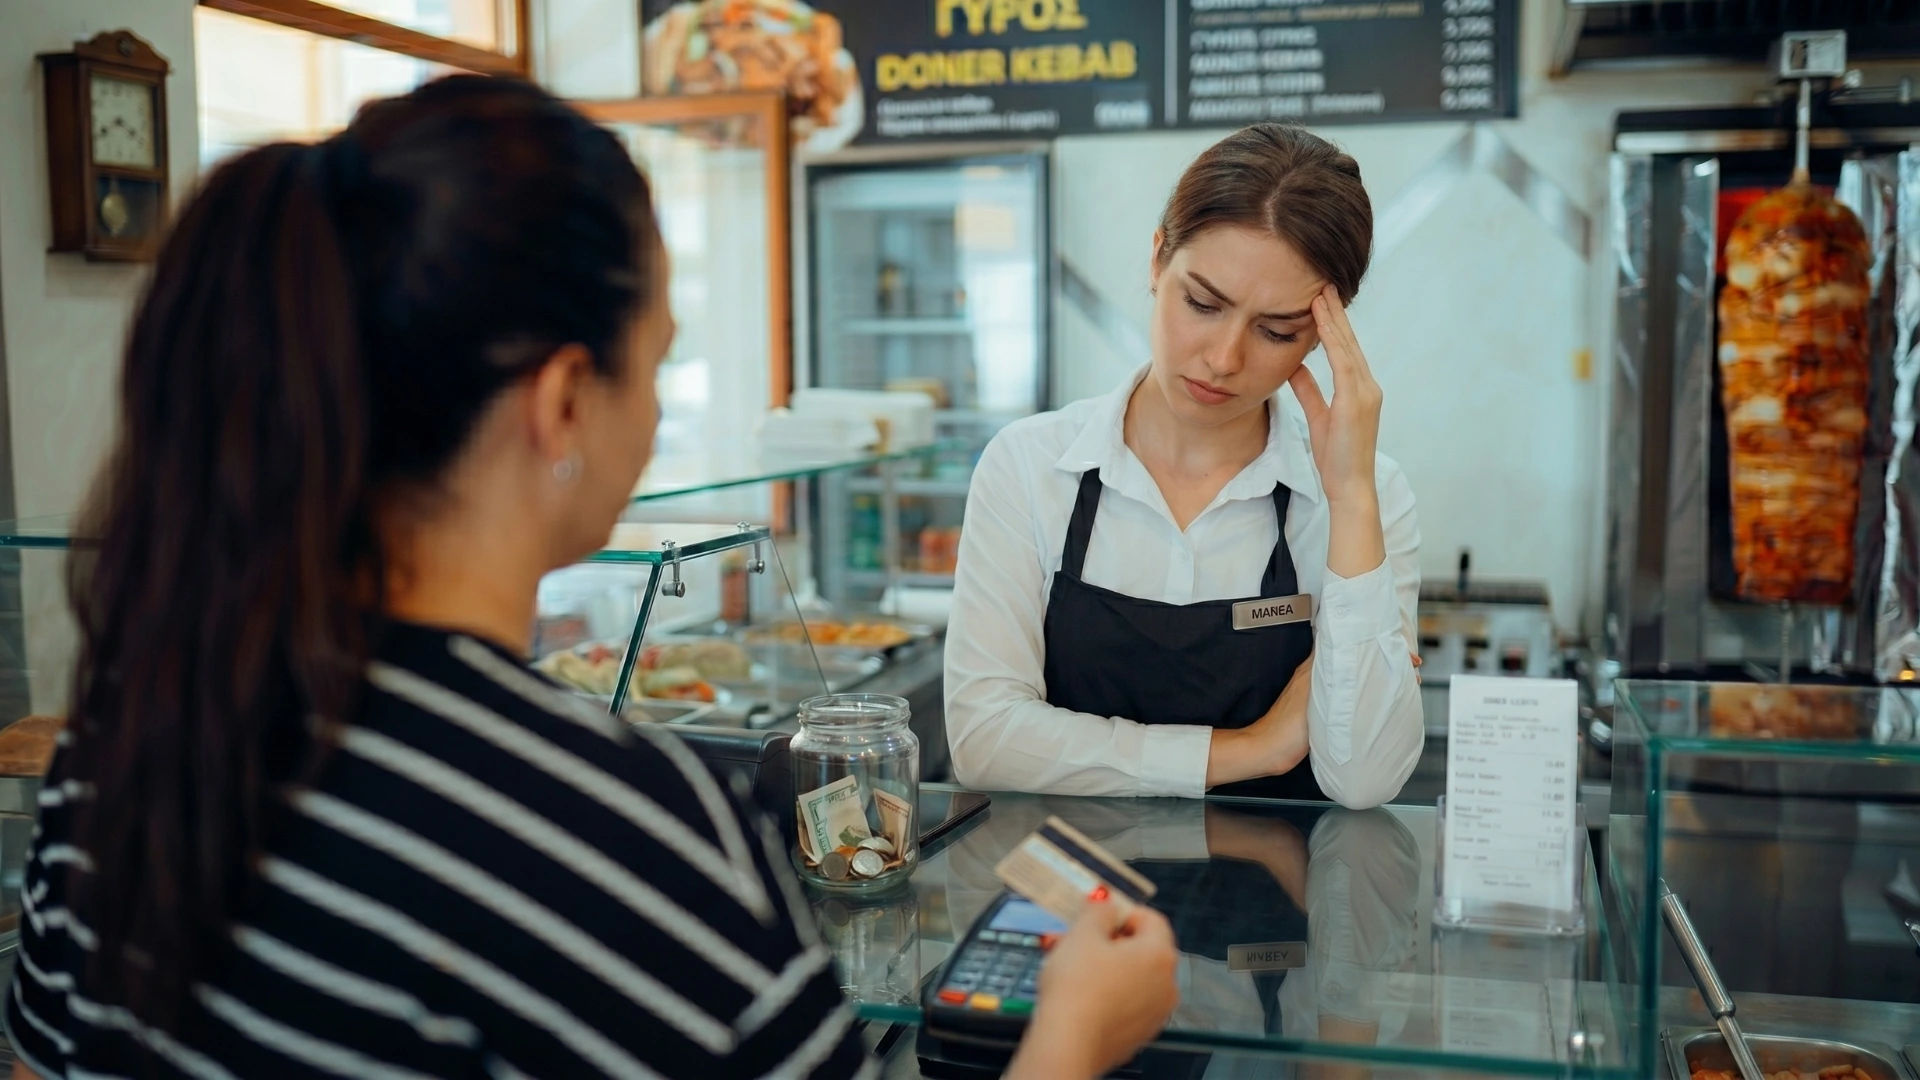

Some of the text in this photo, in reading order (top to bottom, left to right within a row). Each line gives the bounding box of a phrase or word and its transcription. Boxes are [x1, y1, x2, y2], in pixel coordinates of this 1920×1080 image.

[876, 41, 1137, 91] DONER KEBAB
[1251, 604, 1294, 619] MANEA
